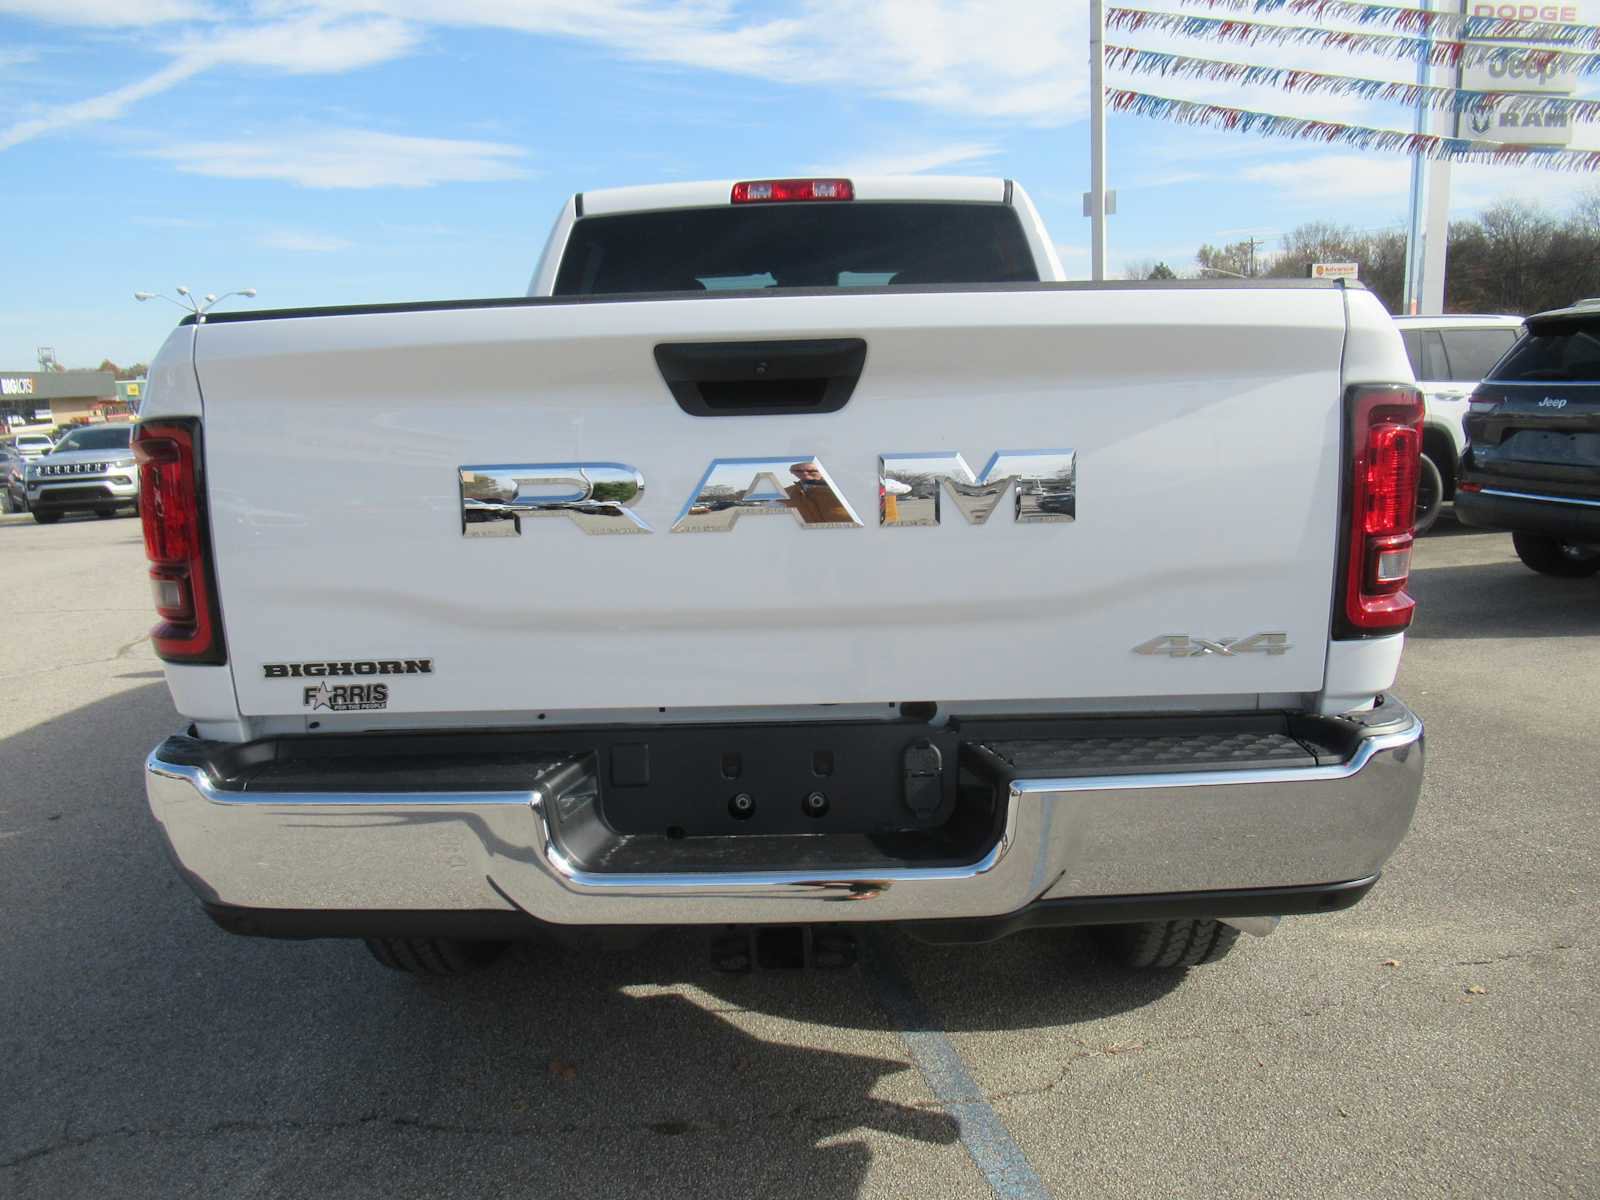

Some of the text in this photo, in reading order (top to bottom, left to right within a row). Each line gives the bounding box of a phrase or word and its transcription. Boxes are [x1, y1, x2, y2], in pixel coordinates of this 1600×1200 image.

[1474, 4, 1577, 22] DODGE
[1500, 111, 1568, 128] RAM
[1538, 397, 1567, 409] Jeep
[458, 449, 1077, 537] RAM
[303, 681, 389, 711] FRRIS
